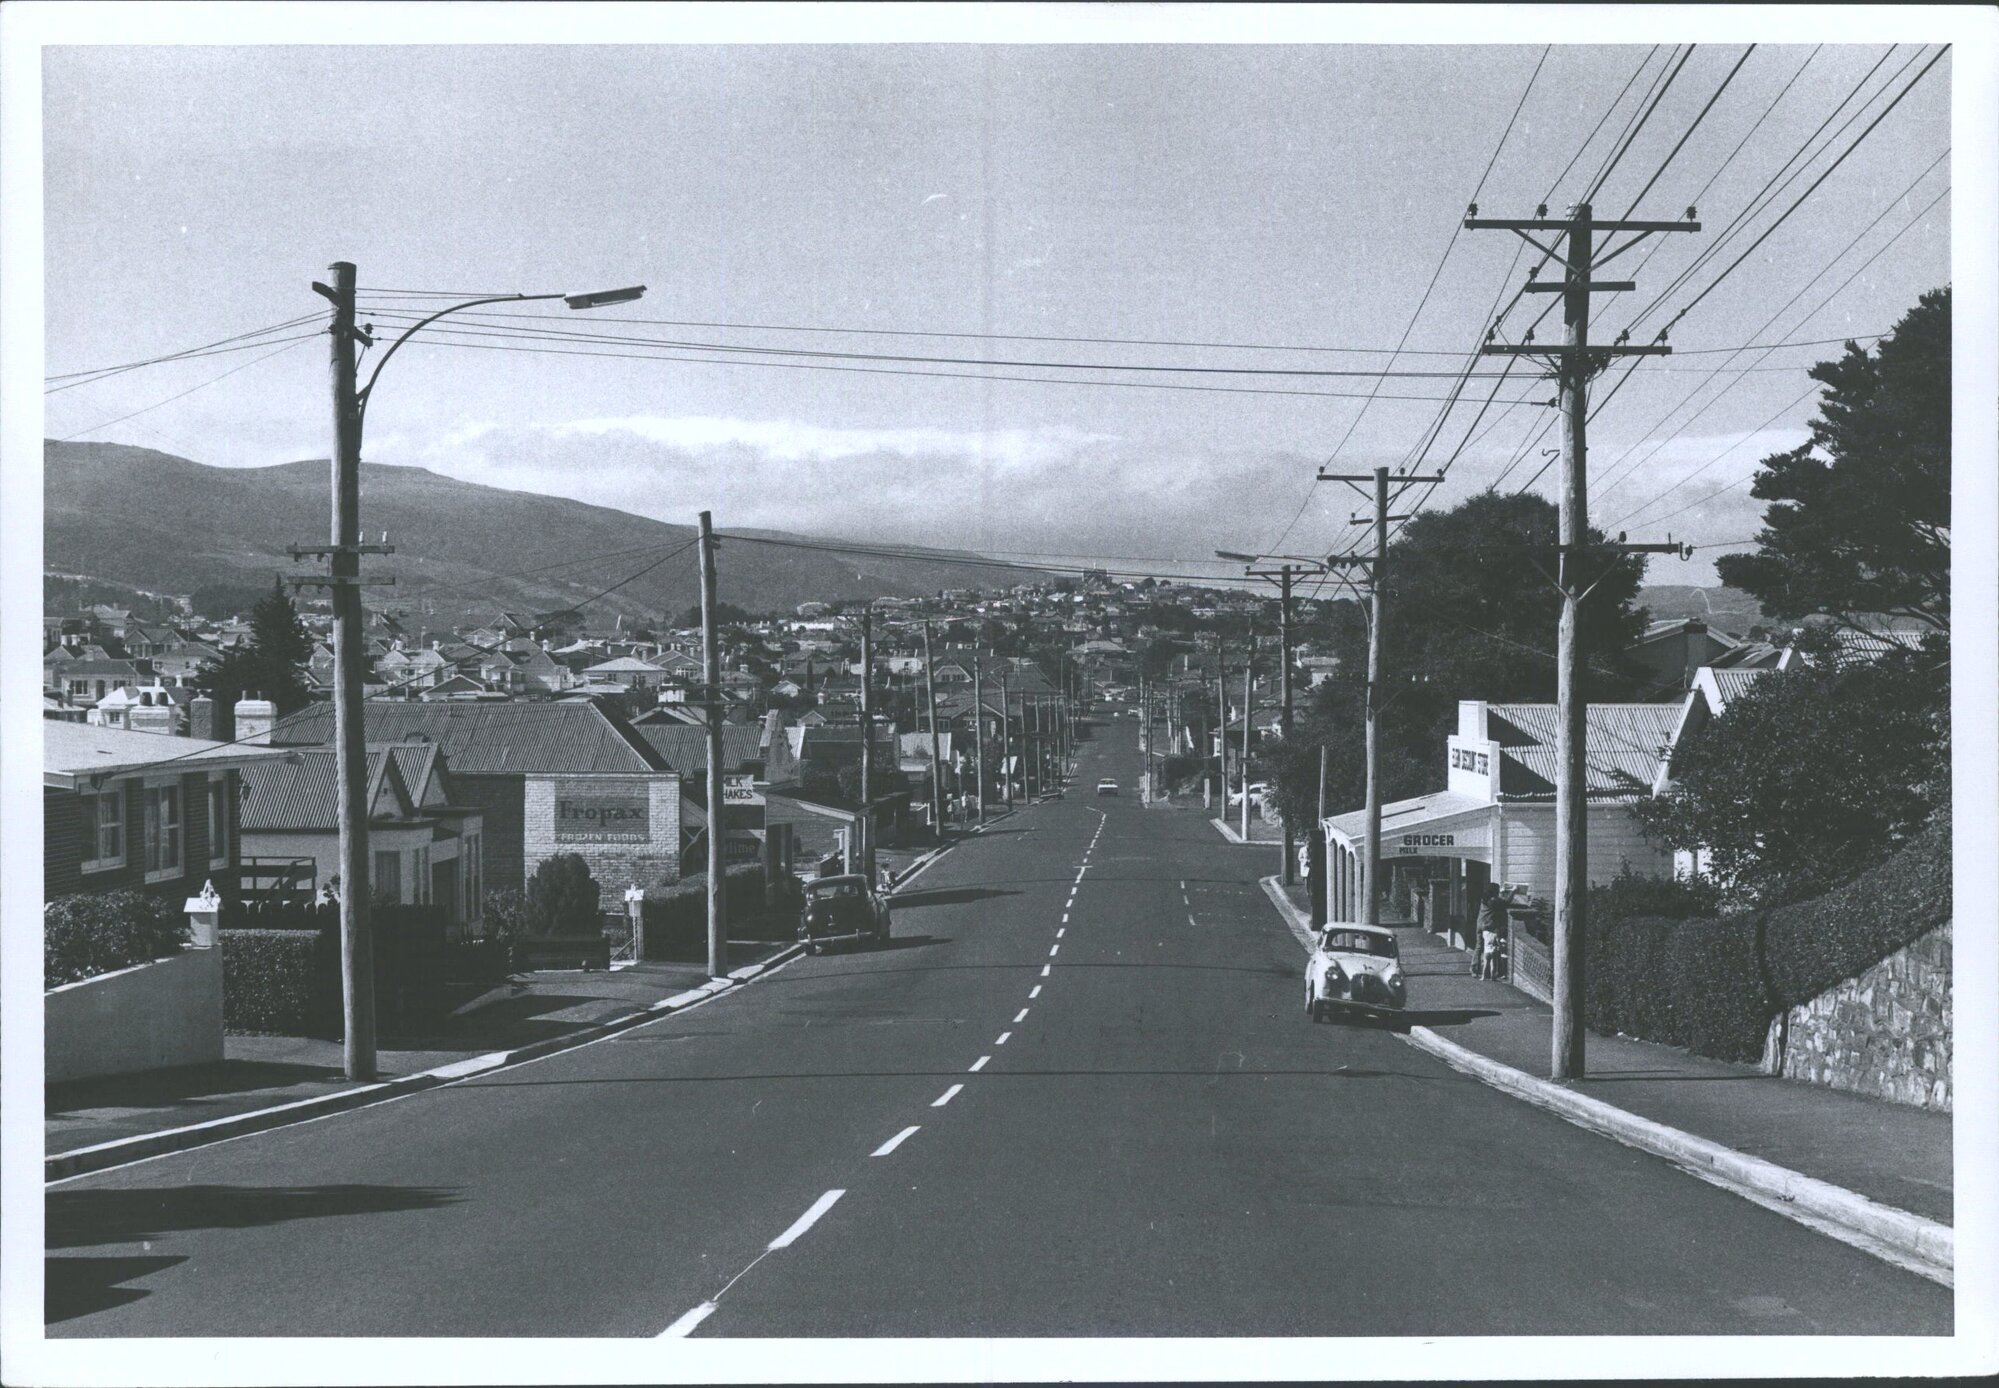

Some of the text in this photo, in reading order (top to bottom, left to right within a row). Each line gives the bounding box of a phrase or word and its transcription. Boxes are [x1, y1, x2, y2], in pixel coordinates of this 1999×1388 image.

[723, 788, 753, 799] HAKES
[559, 801, 645, 827] Fropax
[561, 833, 645, 842] FROZEN FOODS
[1403, 834, 1454, 846] GROCER
